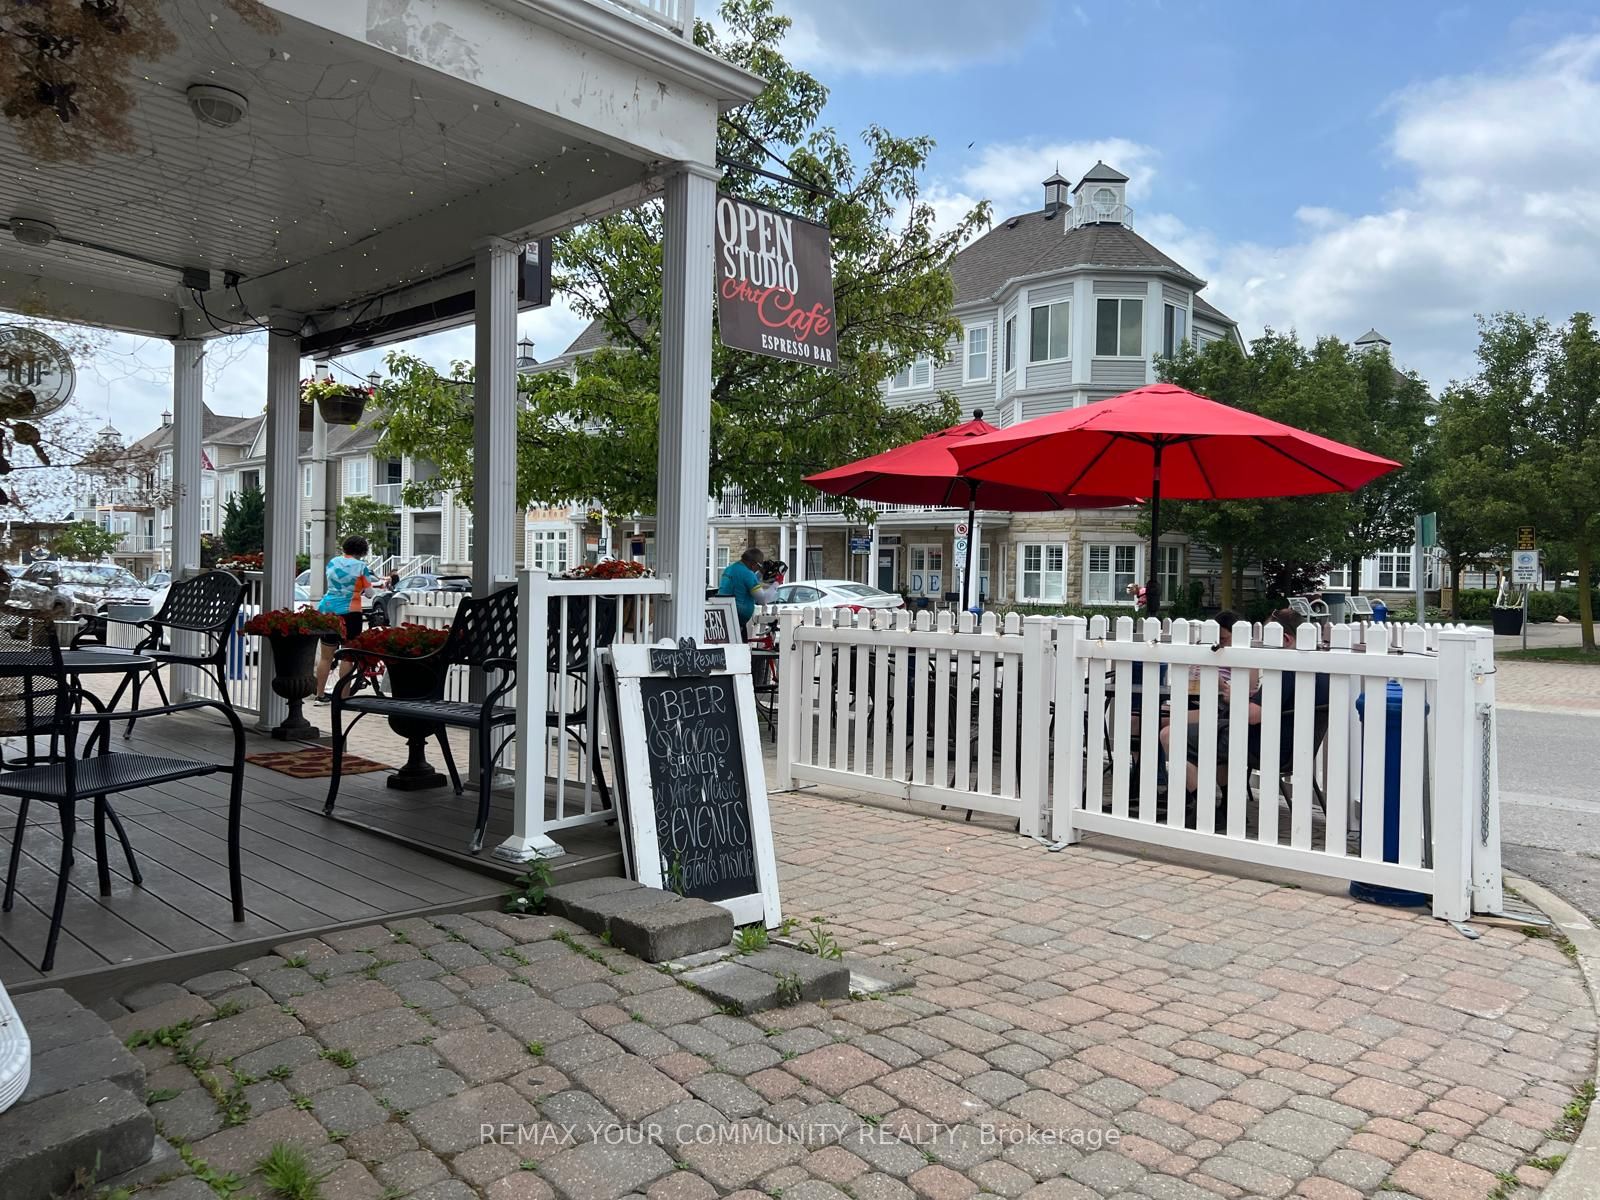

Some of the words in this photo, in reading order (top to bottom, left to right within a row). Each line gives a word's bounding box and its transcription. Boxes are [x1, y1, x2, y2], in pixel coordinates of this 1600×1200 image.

[717, 198, 793, 264] OPEN
[723, 246, 799, 295] STUDIO
[722, 278, 764, 303] Art
[757, 287, 831, 341] Café
[761, 334, 810, 358] ESPRESSO
[813, 345, 832, 363] BAR
[704, 611, 723, 629] PEN
[652, 650, 685, 671] Events
[660, 686, 726, 721] BEER
[670, 752, 718, 779] SERVED
[702, 775, 740, 804] Music
[672, 801, 747, 853] EVENTS
[679, 848, 719, 893] details
[719, 845, 754, 880] inside
